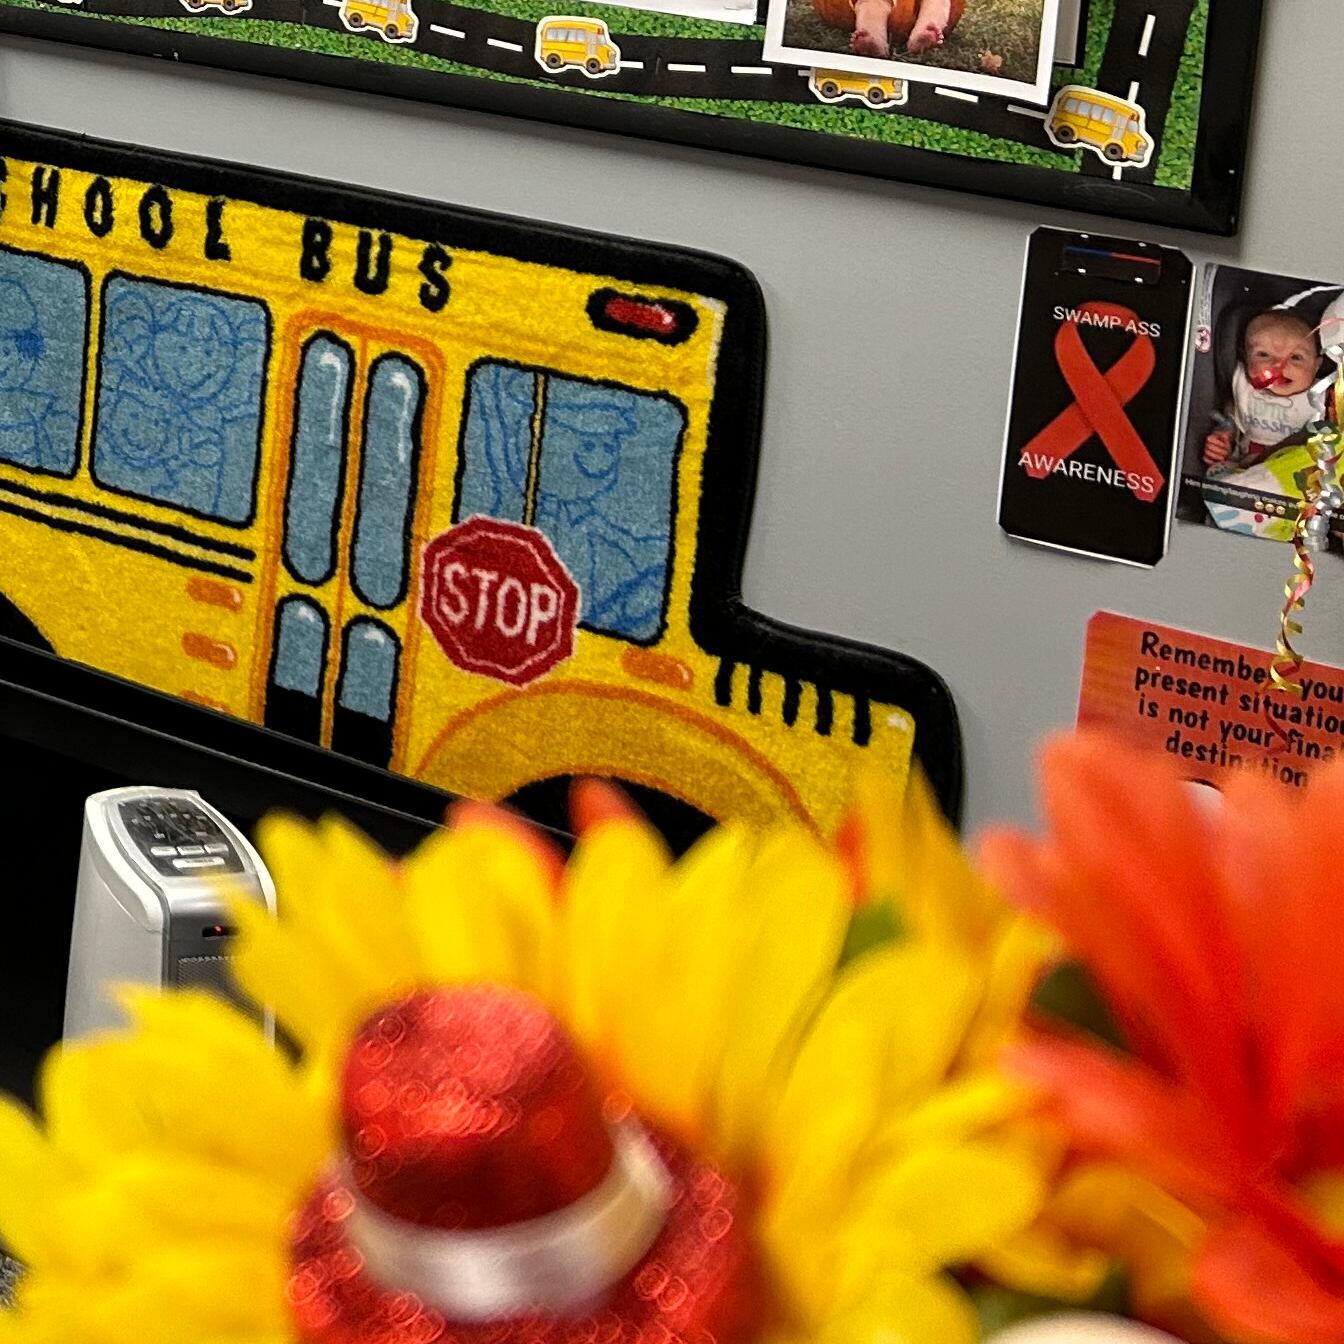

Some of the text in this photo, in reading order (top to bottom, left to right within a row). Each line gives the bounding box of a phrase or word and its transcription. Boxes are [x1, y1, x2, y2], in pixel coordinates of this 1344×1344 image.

[0, 156, 452, 314] HOOL BUS
[1053, 304, 1161, 338] SWAMP ASS
[1018, 452, 1155, 493] AWARENESS
[441, 563, 558, 645] STOP
[1141, 631, 1269, 684] Remembe
[1135, 666, 1344, 732] present situatio
[1139, 693, 1275, 747] is not your
